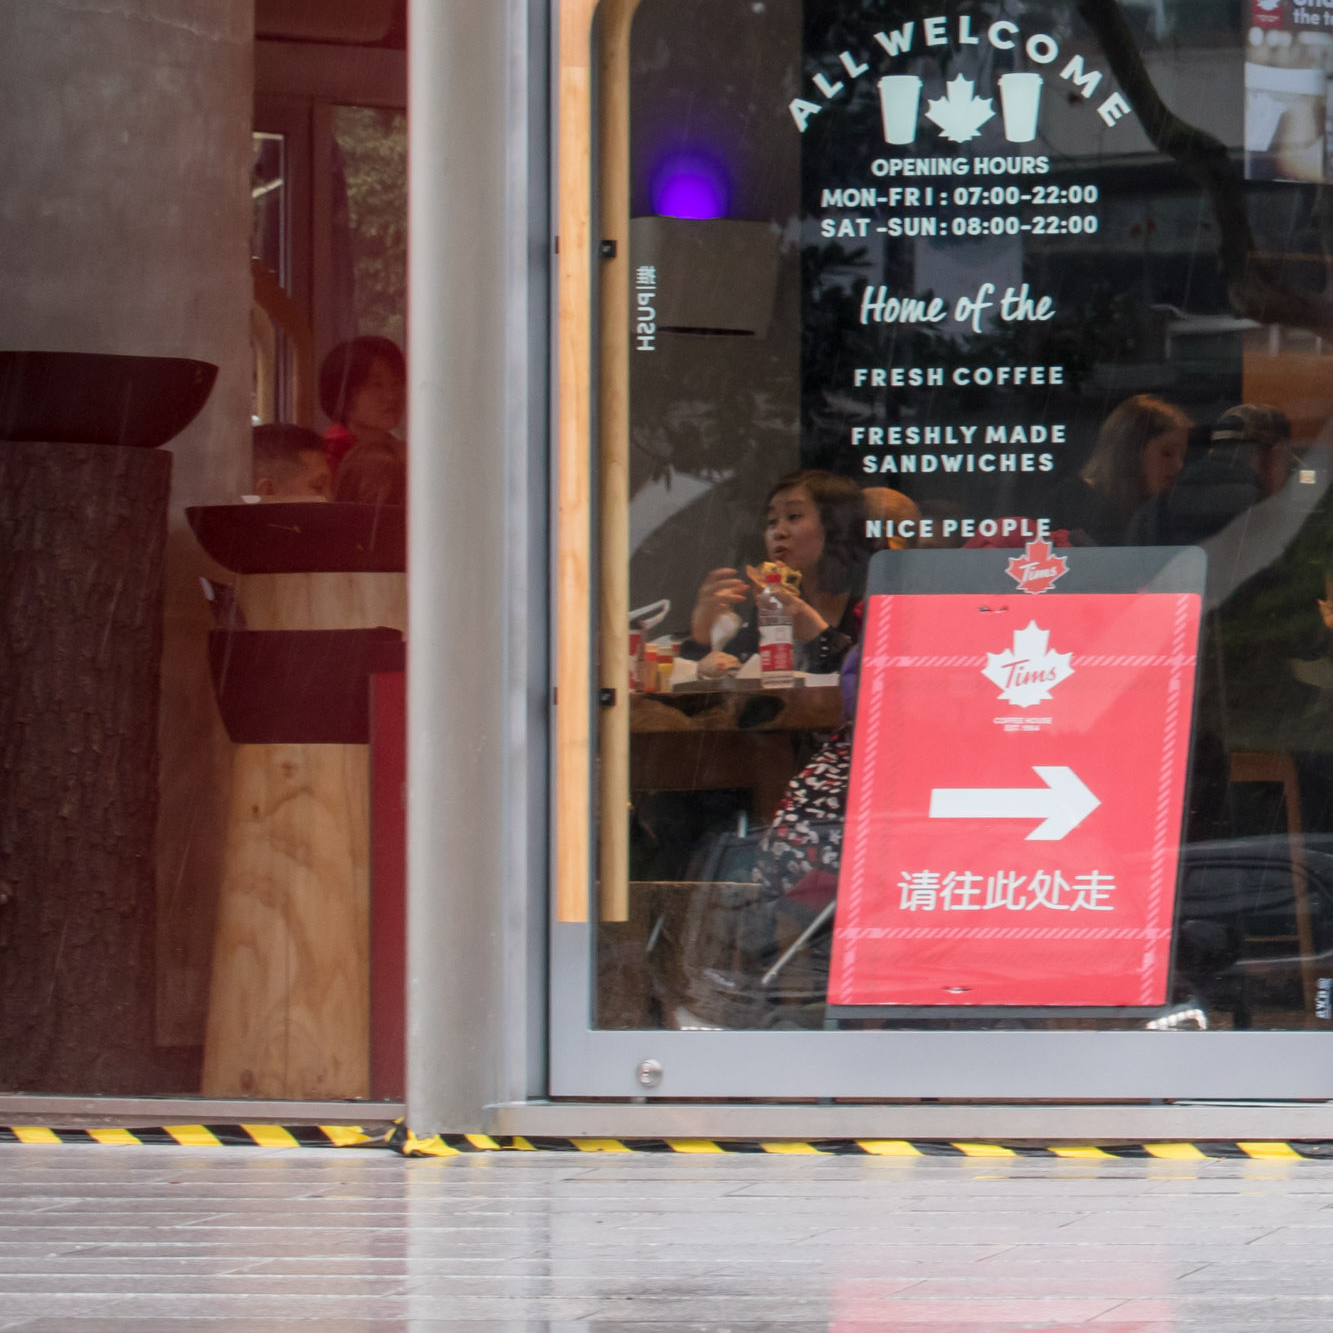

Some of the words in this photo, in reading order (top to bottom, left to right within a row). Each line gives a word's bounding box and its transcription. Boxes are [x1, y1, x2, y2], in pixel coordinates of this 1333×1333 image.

[1293, 8, 1320, 25] the
[788, 50, 869, 133] ALL
[873, 15, 1132, 128] WELCOME
[871, 157, 969, 177] OPENING
[974, 156, 1049, 175] HOURS
[953, 185, 1098, 206] 07:00-22:00
[952, 215, 1098, 236] 08:00-22:00
[860, 285, 947, 325] Home
[954, 282, 995, 334] of
[1000, 283, 1056, 321] the
[854, 368, 943, 387] FRESH
[953, 366, 1063, 386] COFFEE
[851, 426, 977, 445] FRESHLY
[985, 425, 1066, 444] MADE
[862, 453, 1053, 473] SANDWICHES
[865, 519, 934, 538] NICE
[943, 518, 1051, 538] PEOPLE
[1018, 561, 1058, 583] Tims
[1001, 658, 1057, 689] Tims
[896, 869, 1117, 912] 请往此处走
